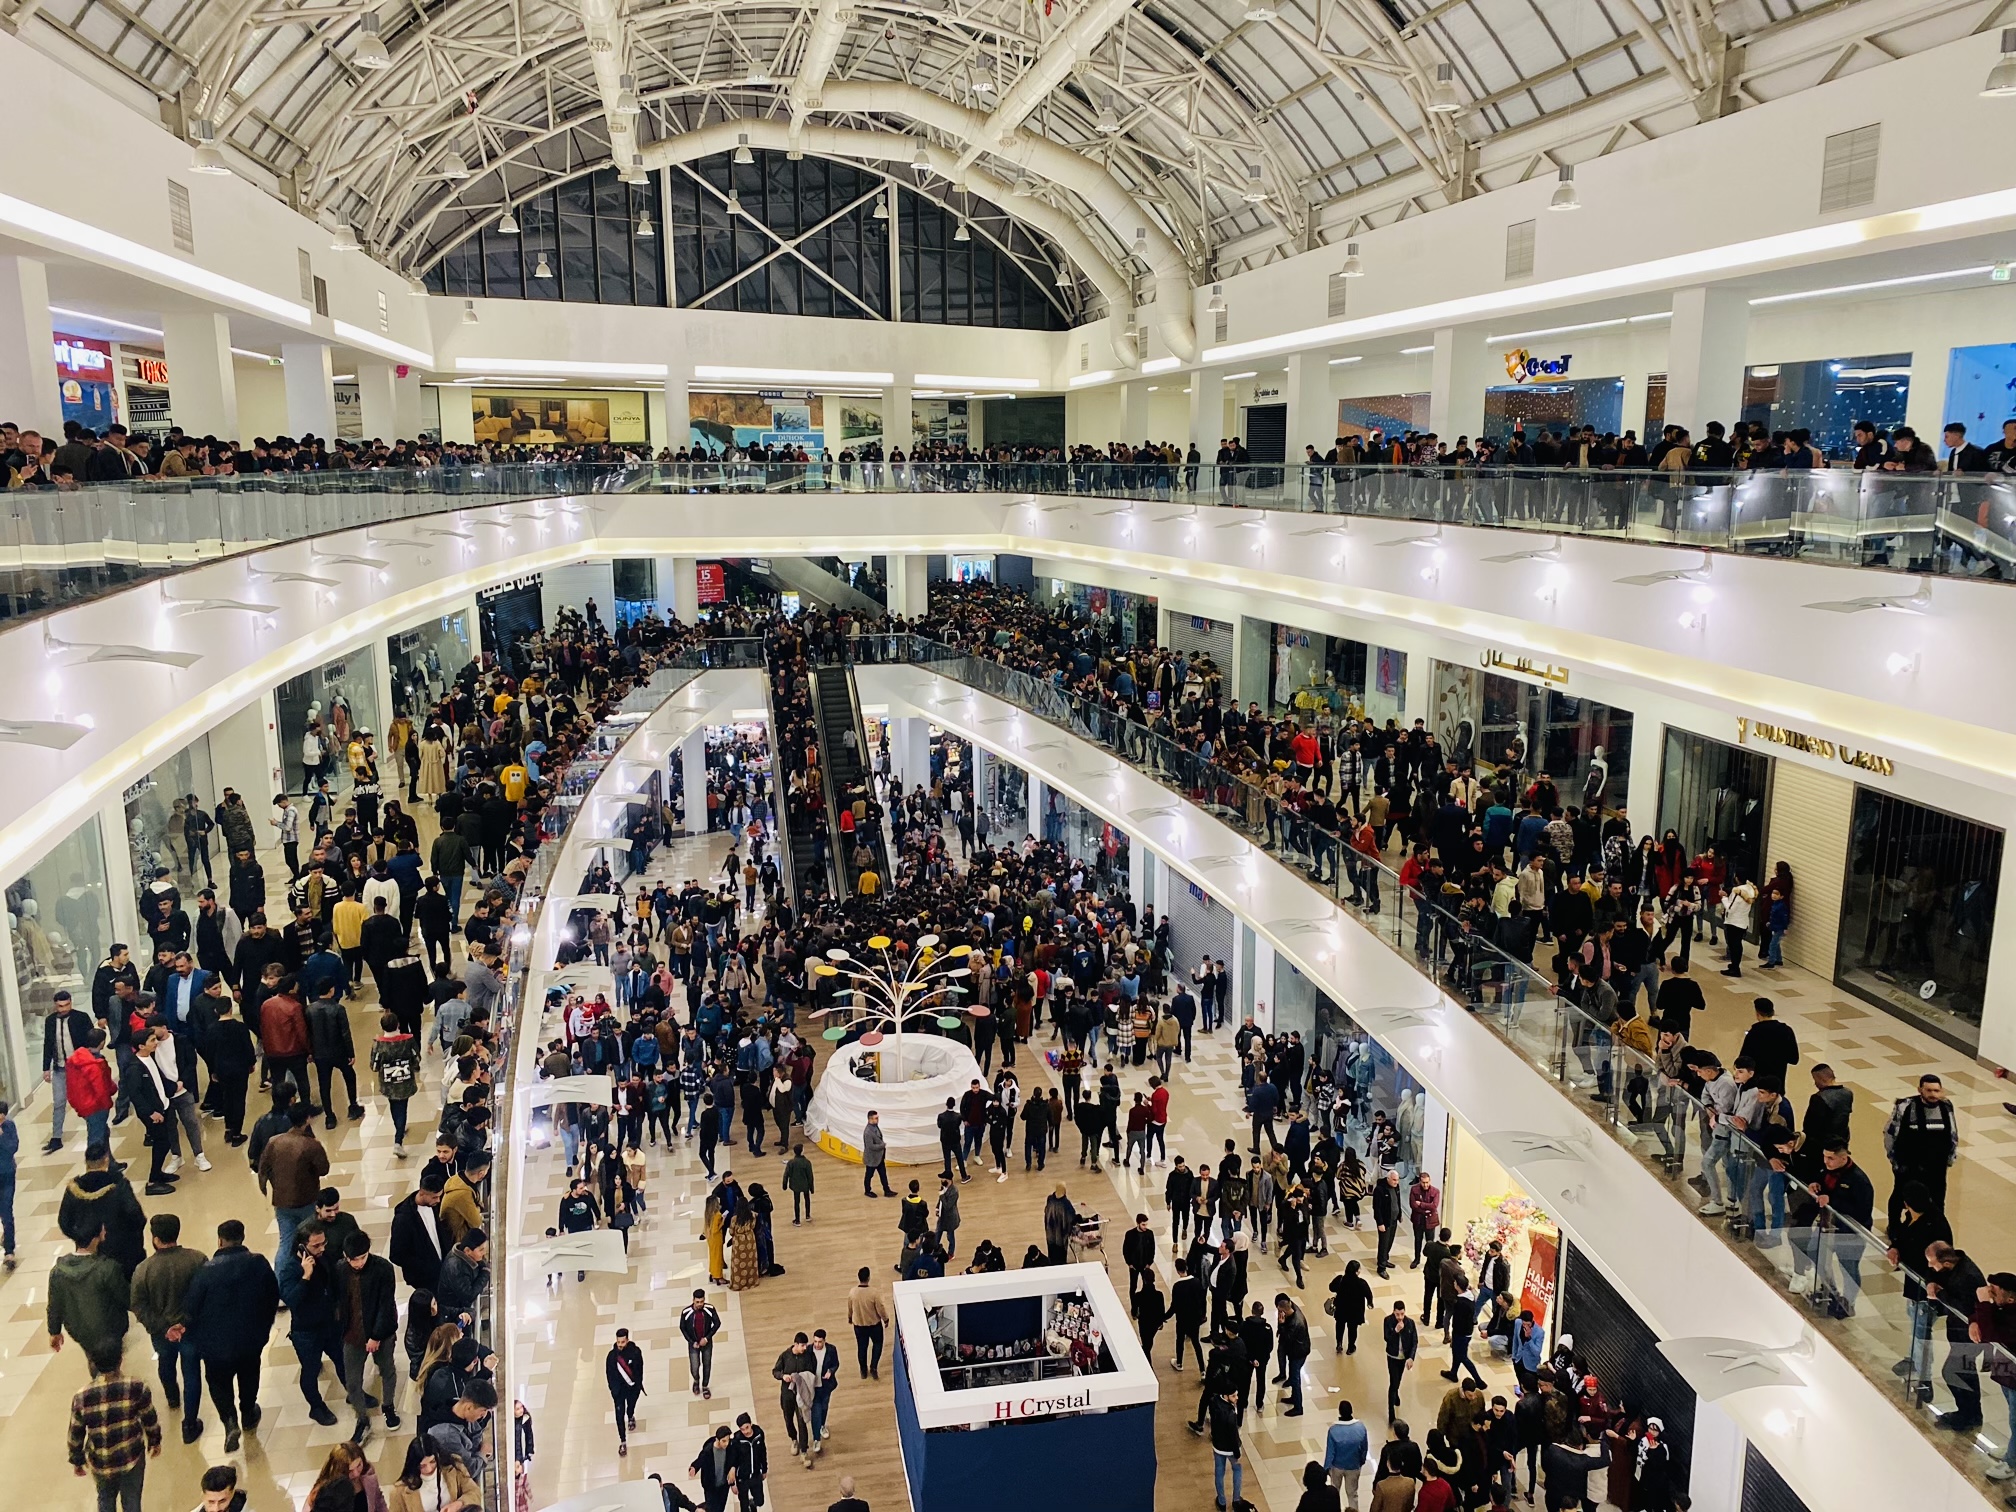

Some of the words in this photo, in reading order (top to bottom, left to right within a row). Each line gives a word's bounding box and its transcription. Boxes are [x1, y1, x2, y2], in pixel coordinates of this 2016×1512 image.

[701, 569, 711, 580] 15
[1524, 1278, 1551, 1305] PRICE
[1526, 1267, 1555, 1293] HALF
[996, 1400, 1013, 1419] H
[1020, 1388, 1091, 1416] Crystal
